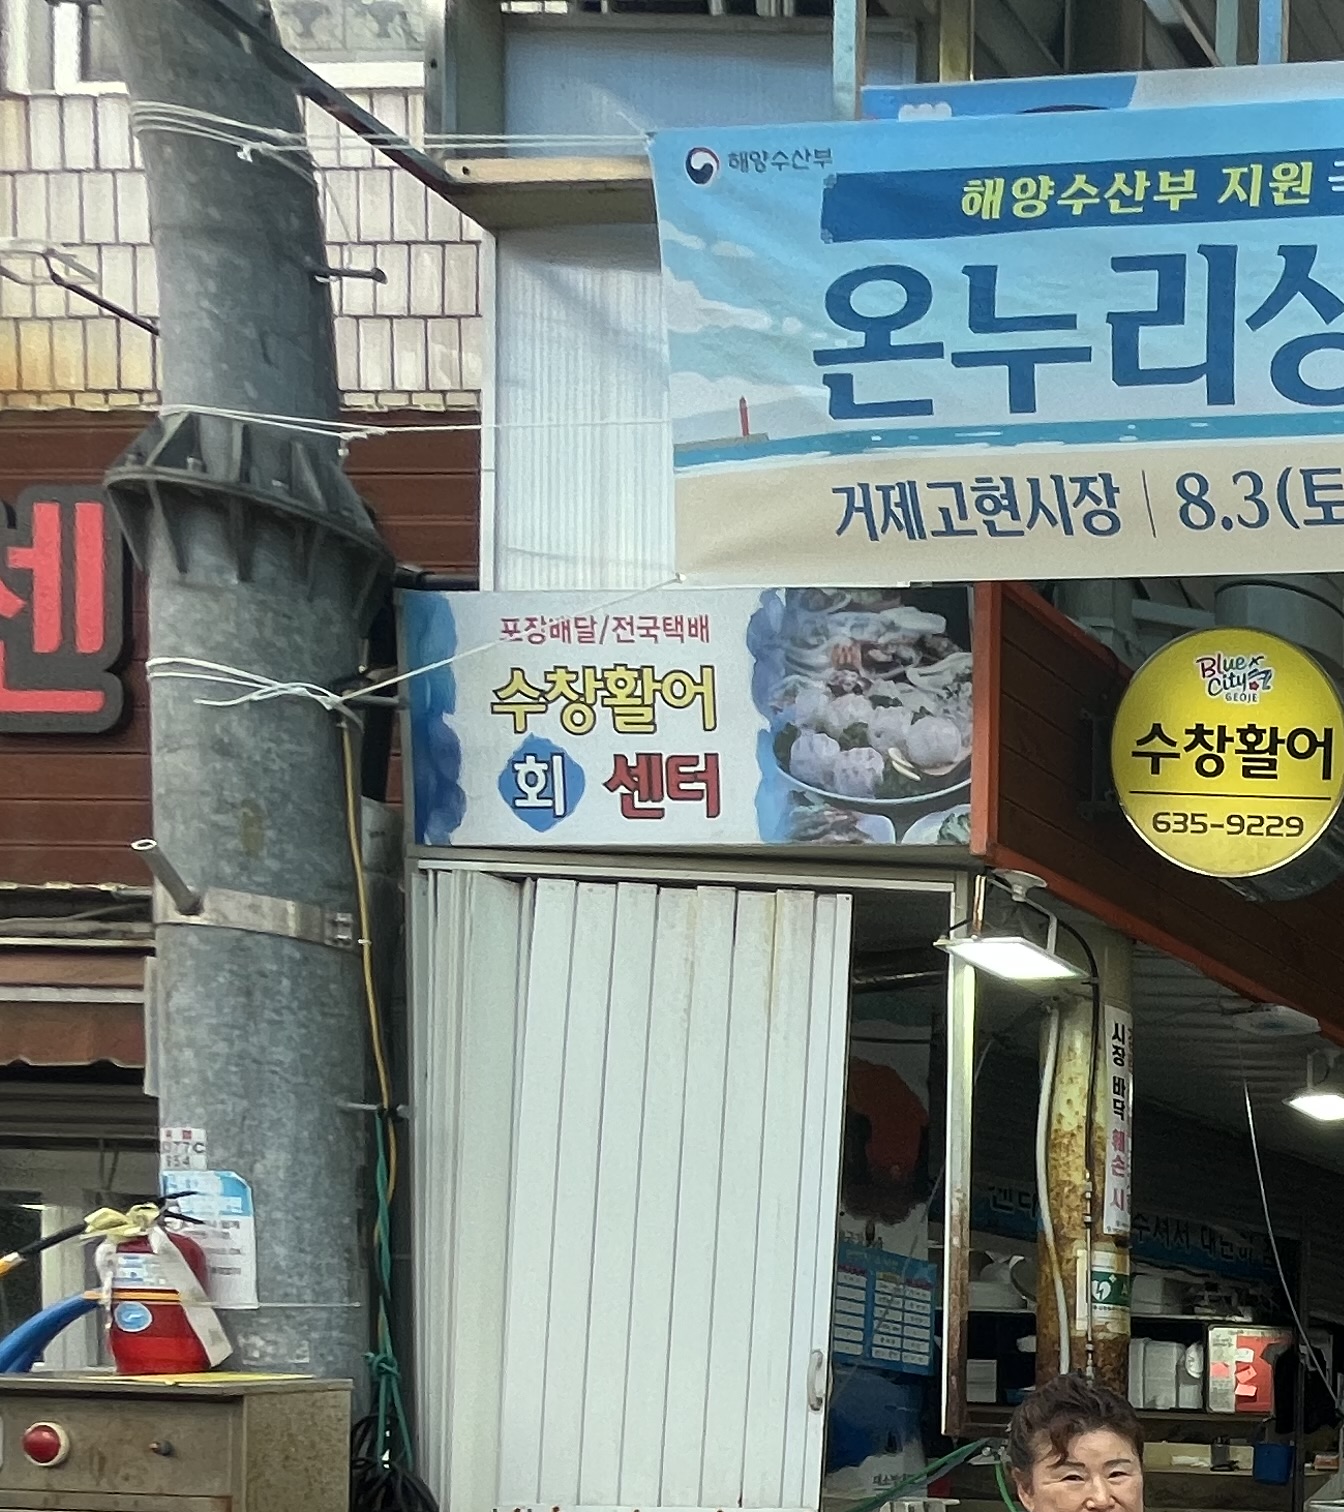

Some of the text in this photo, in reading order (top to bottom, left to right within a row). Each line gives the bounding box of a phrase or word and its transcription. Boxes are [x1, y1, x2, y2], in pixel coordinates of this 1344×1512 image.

[728, 148, 833, 172] 해양수산부
[961, 173, 1199, 221] 해양수산부
[1222, 161, 1314, 208] 지원
[832, 471, 1121, 542] 거제고현시장
[501, 615, 710, 645] 포장배달/전국택배
[1197, 653, 1246, 679] Blue
[1208, 671, 1247, 697] City
[491, 663, 718, 735] 수창활어
[1225, 692, 1258, 703] GEOJE
[1131, 722, 1333, 781] 수창활어
[514, 751, 721, 819] 회 센터
[1152, 811, 1304, 837] 635-9229
[1111, 1022, 1126, 1067] 시장
[1111, 1075, 1126, 1122] 바닥
